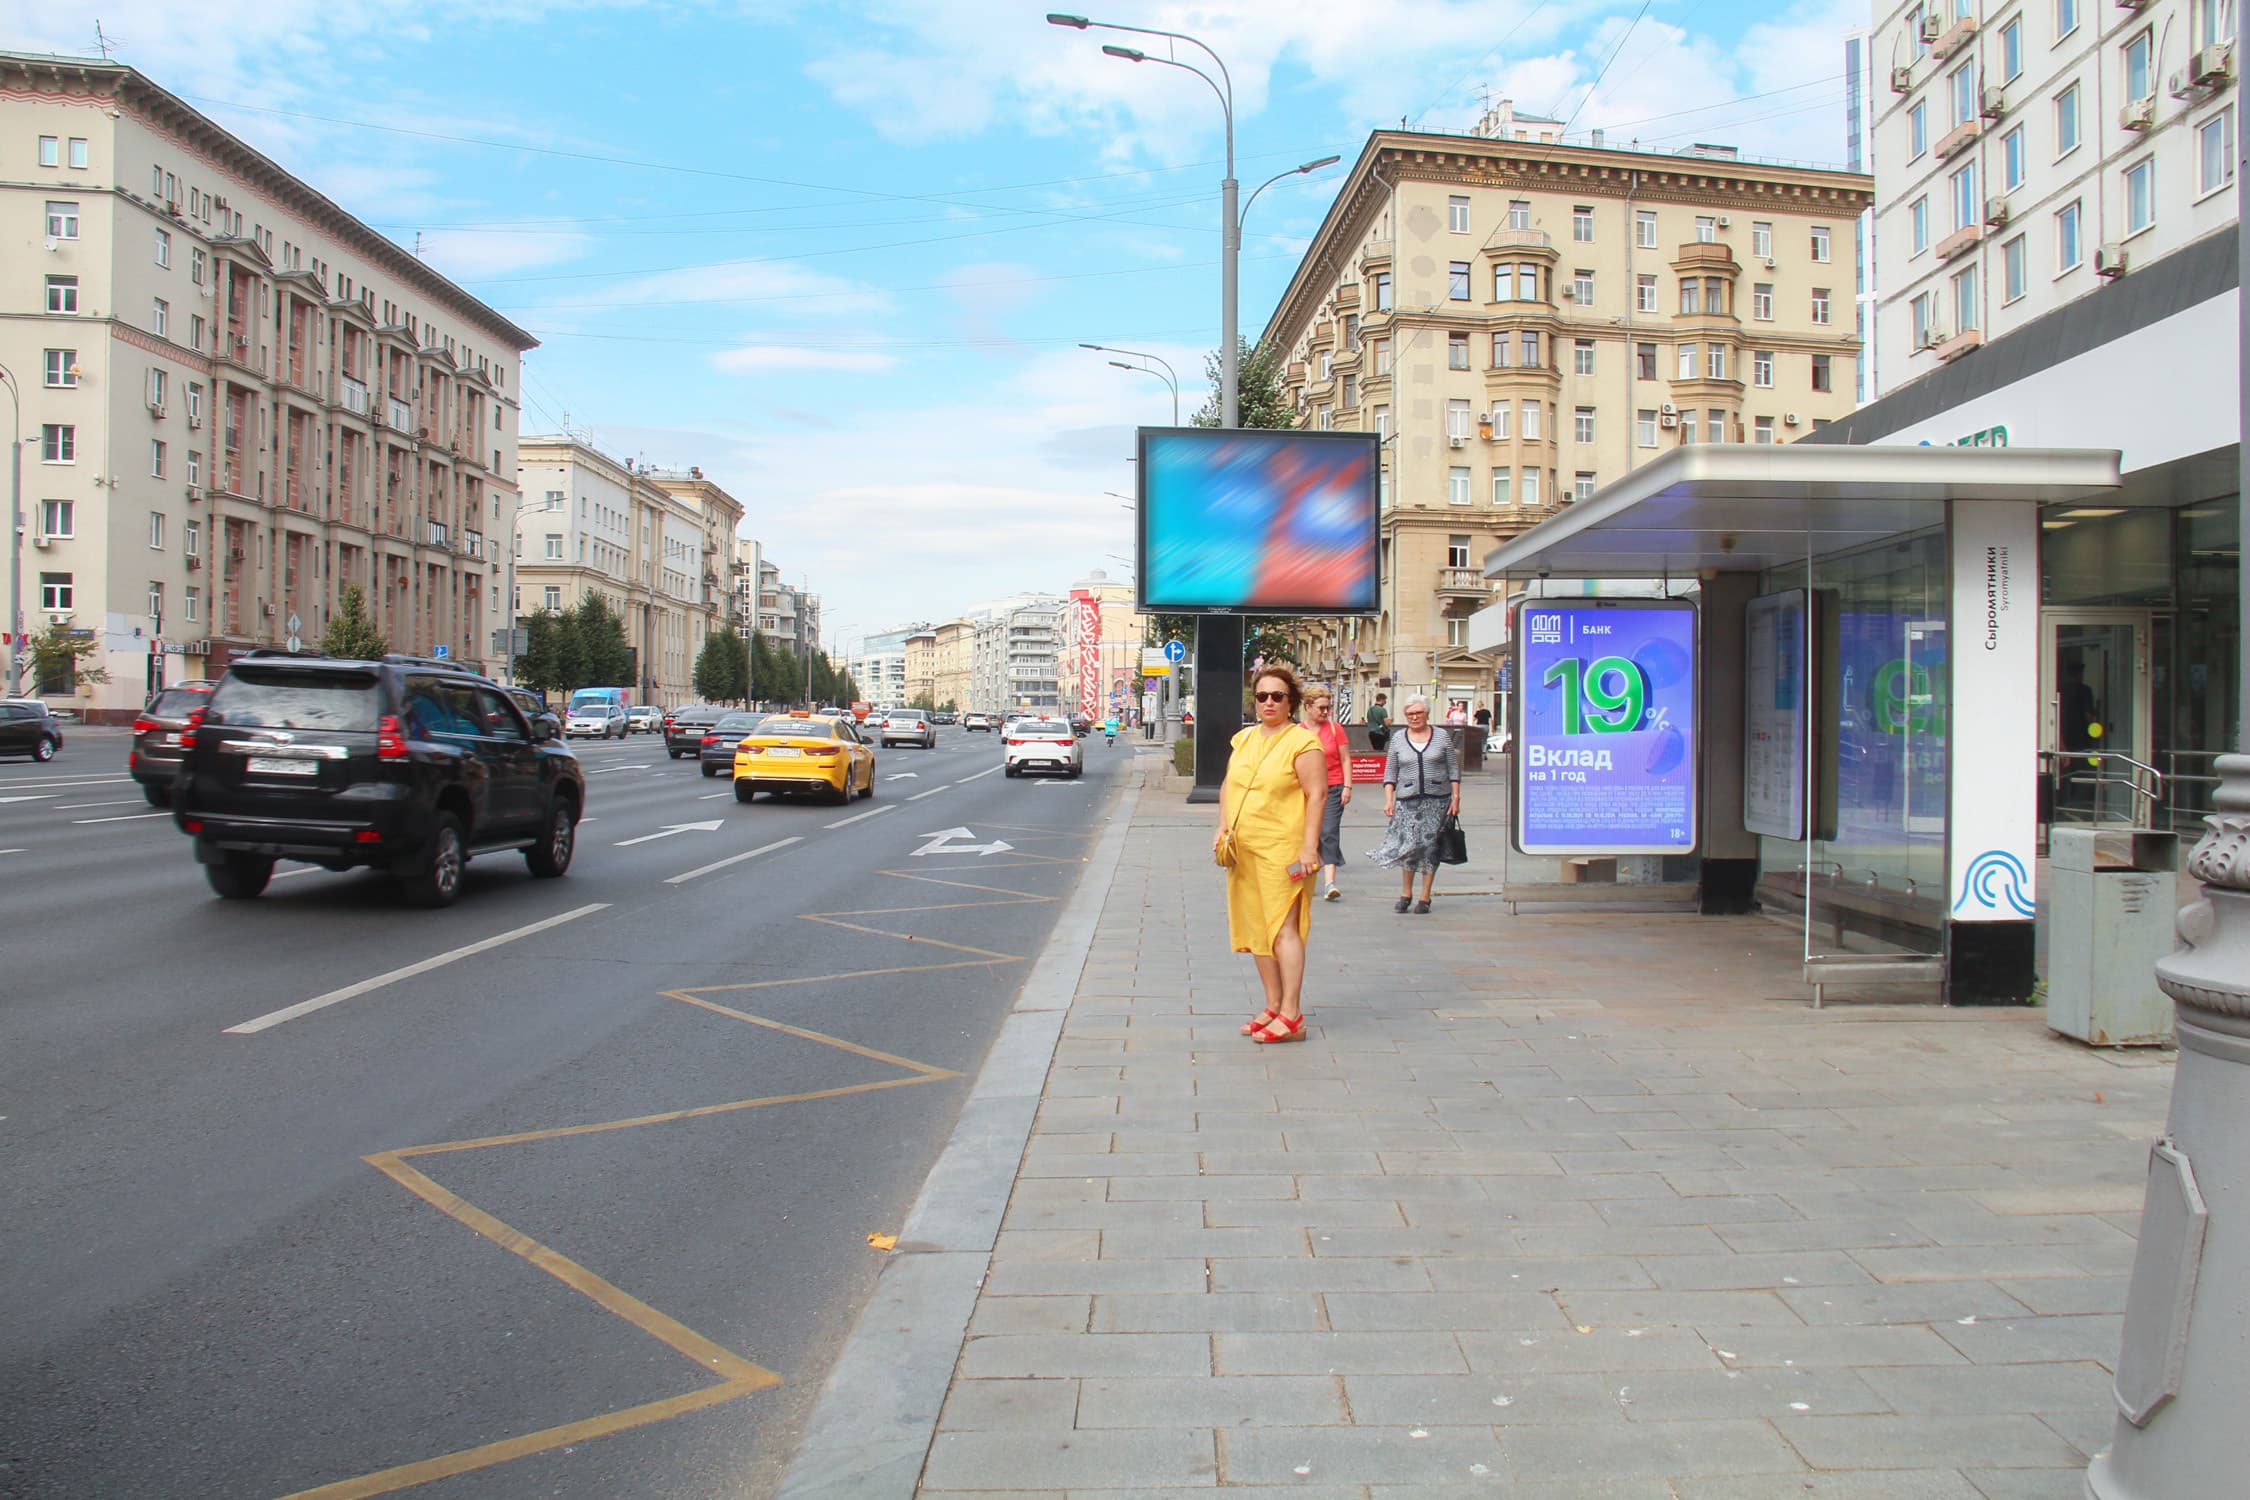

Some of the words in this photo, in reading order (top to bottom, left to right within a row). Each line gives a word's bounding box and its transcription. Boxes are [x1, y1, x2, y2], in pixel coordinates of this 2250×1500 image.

[1999, 546, 2010, 612] Syromyatniki
[1984, 546, 1999, 651] Сыромятники
[1582, 625, 1612, 635] БАНК
[1528, 744, 1613, 771] Вклад
[1529, 772, 1547, 781] на
[1550, 769, 1557, 781] 1
[1561, 772, 1587, 783] год
[1670, 828, 1686, 839] 18+
